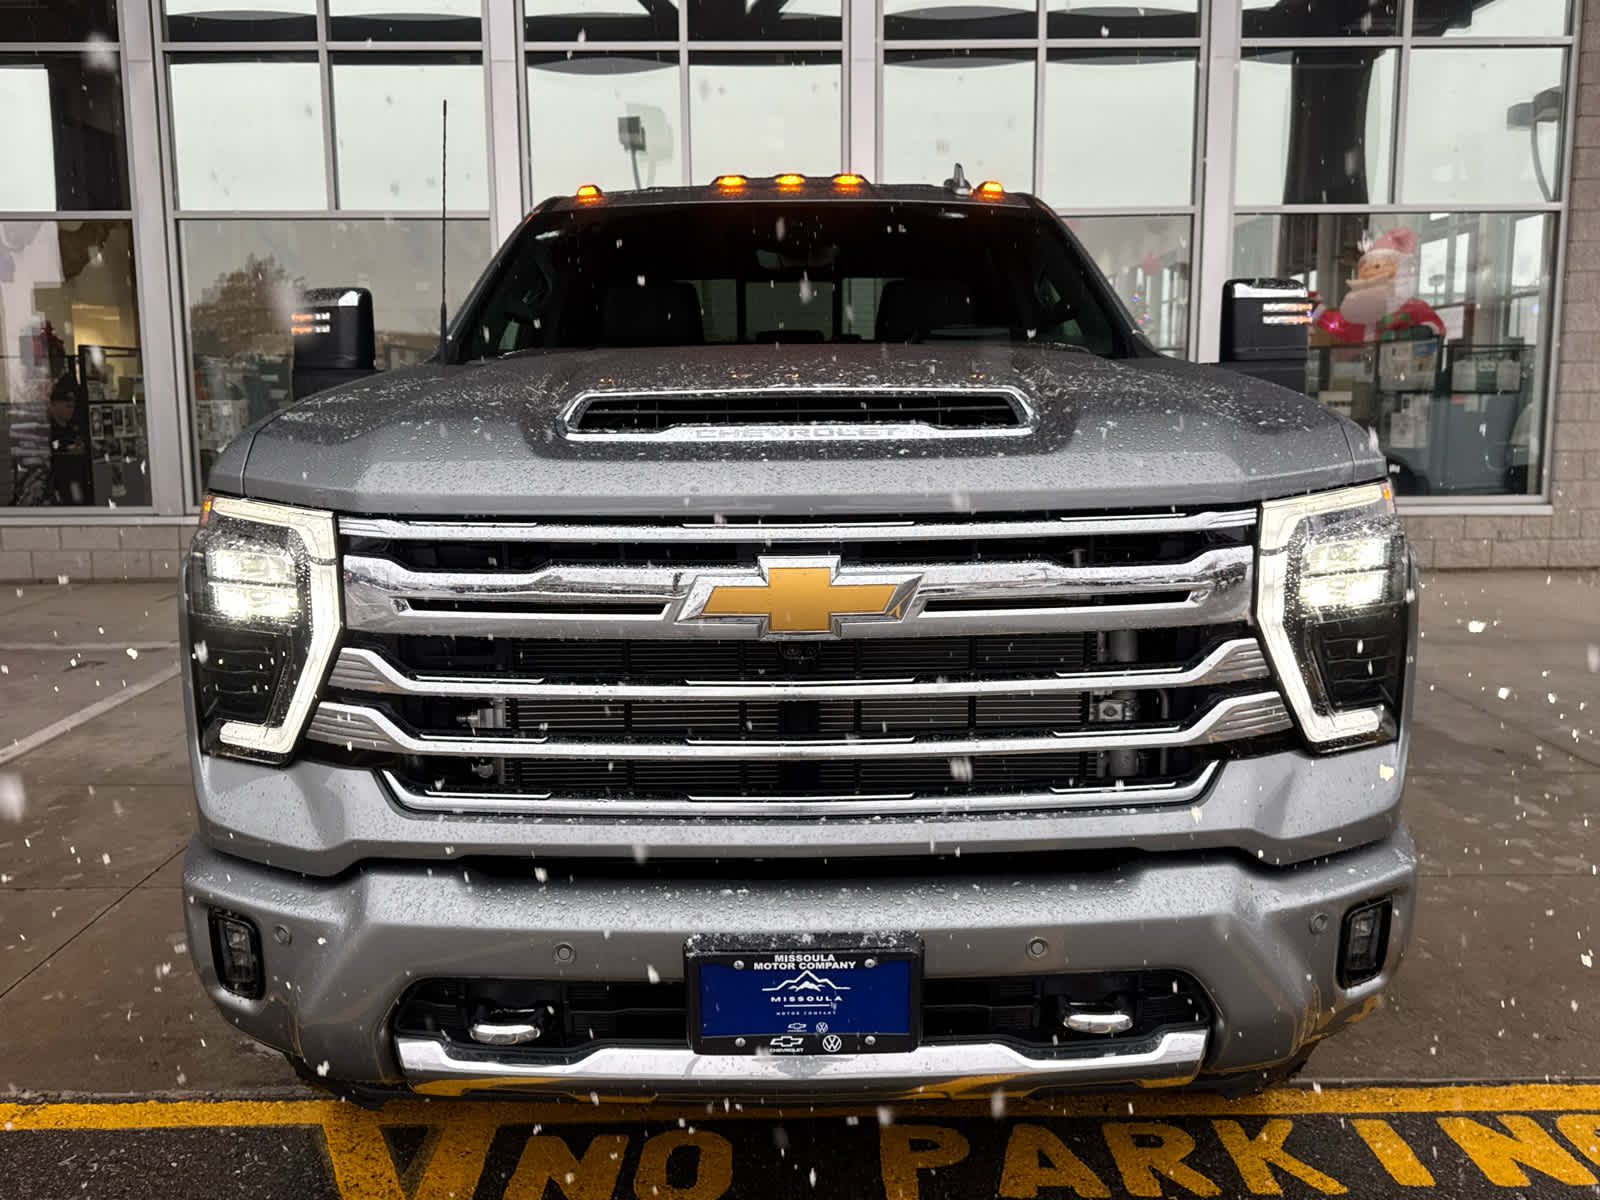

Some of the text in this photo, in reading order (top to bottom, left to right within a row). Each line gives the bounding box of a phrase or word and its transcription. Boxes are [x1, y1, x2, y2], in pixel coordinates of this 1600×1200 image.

[696, 426, 898, 439] CHEVROLET
[774, 954, 836, 962] MISSOULA
[753, 961, 857, 970] MOTOR COMPANY
[770, 995, 843, 1003] MISSOULA
[504, 1128, 733, 1200] NO
